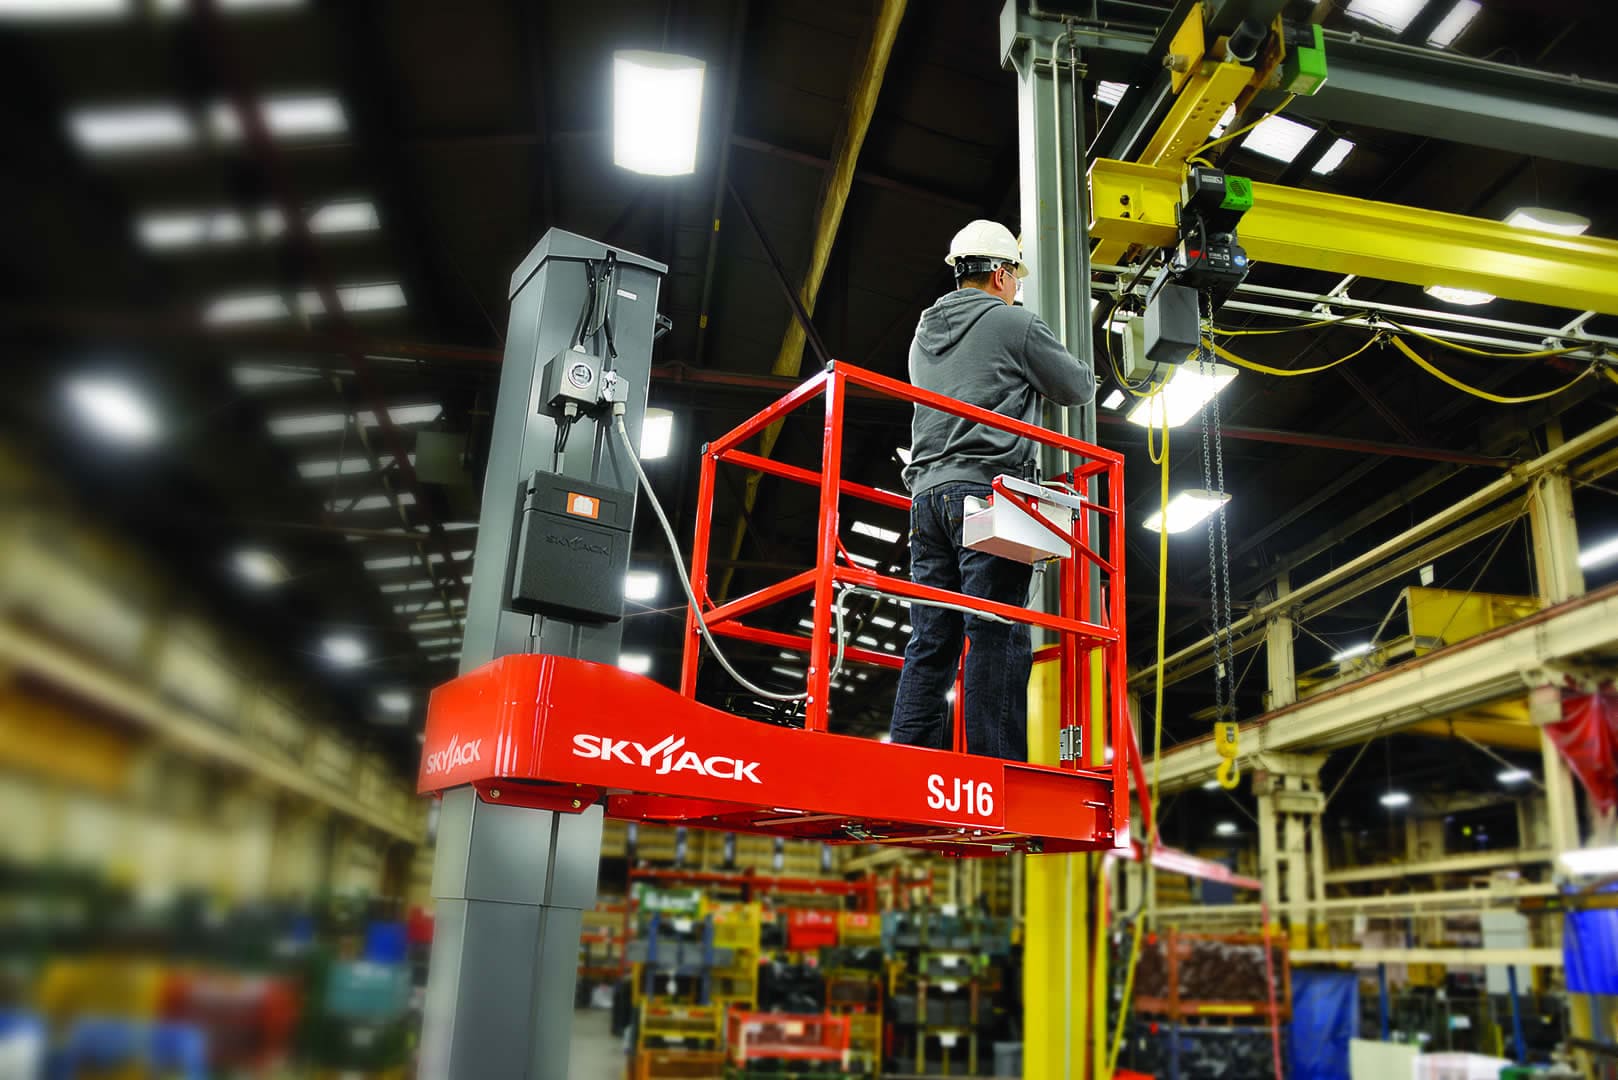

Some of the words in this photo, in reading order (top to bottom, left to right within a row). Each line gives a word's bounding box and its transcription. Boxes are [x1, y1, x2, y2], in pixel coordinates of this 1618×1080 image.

[426, 733, 482, 775] SKYJACK
[572, 733, 763, 784] SKYJACK
[927, 774, 994, 817] SJ16
